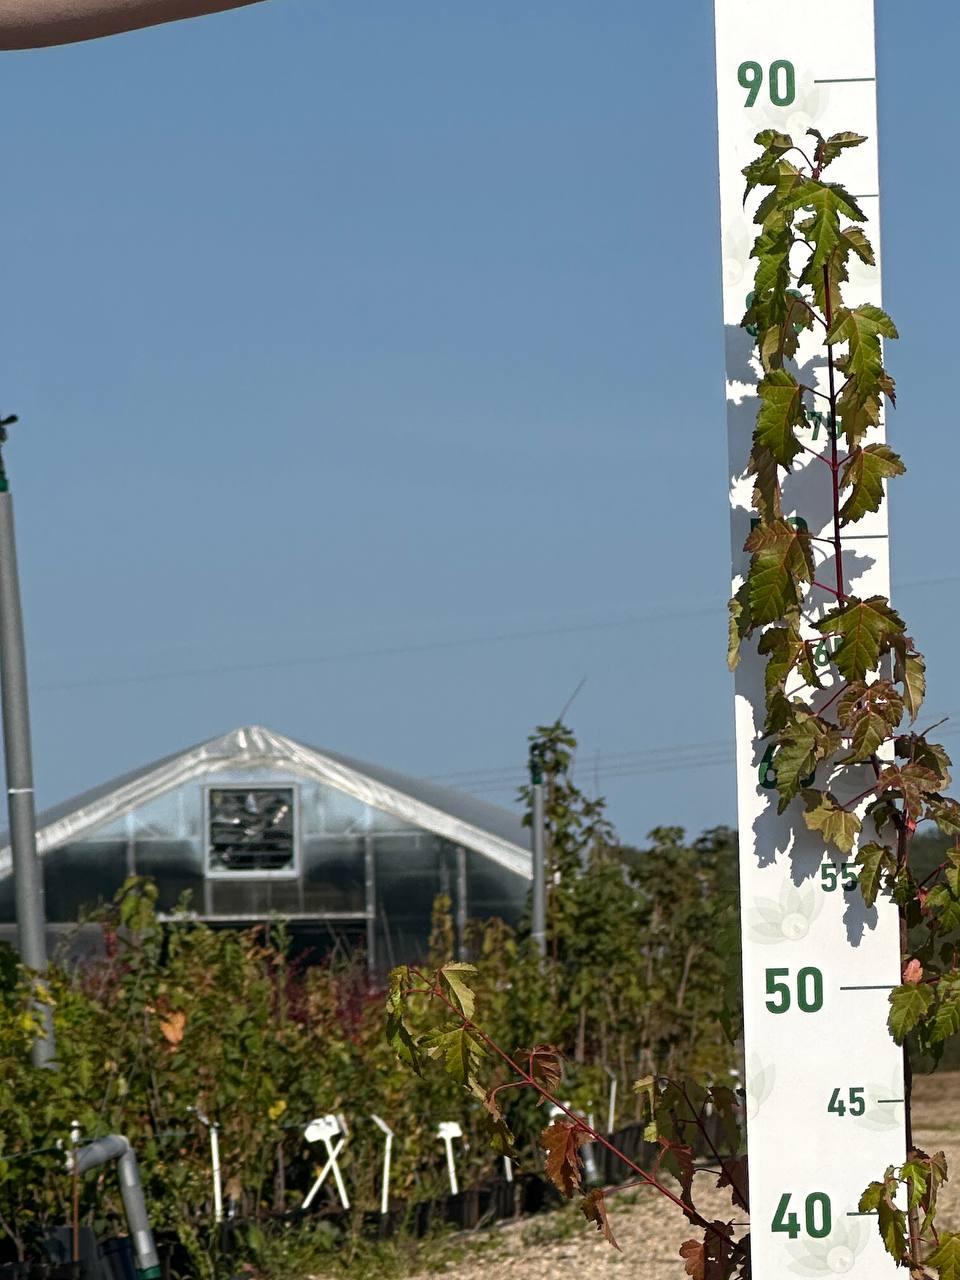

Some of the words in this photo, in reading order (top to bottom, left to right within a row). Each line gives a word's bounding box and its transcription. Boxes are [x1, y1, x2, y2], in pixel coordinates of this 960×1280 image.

[737, 59, 796, 108] 90
[820, 863, 859, 892] 55
[765, 966, 824, 1015] 50
[827, 1086, 866, 1117] 45
[771, 1192, 832, 1239] 40
